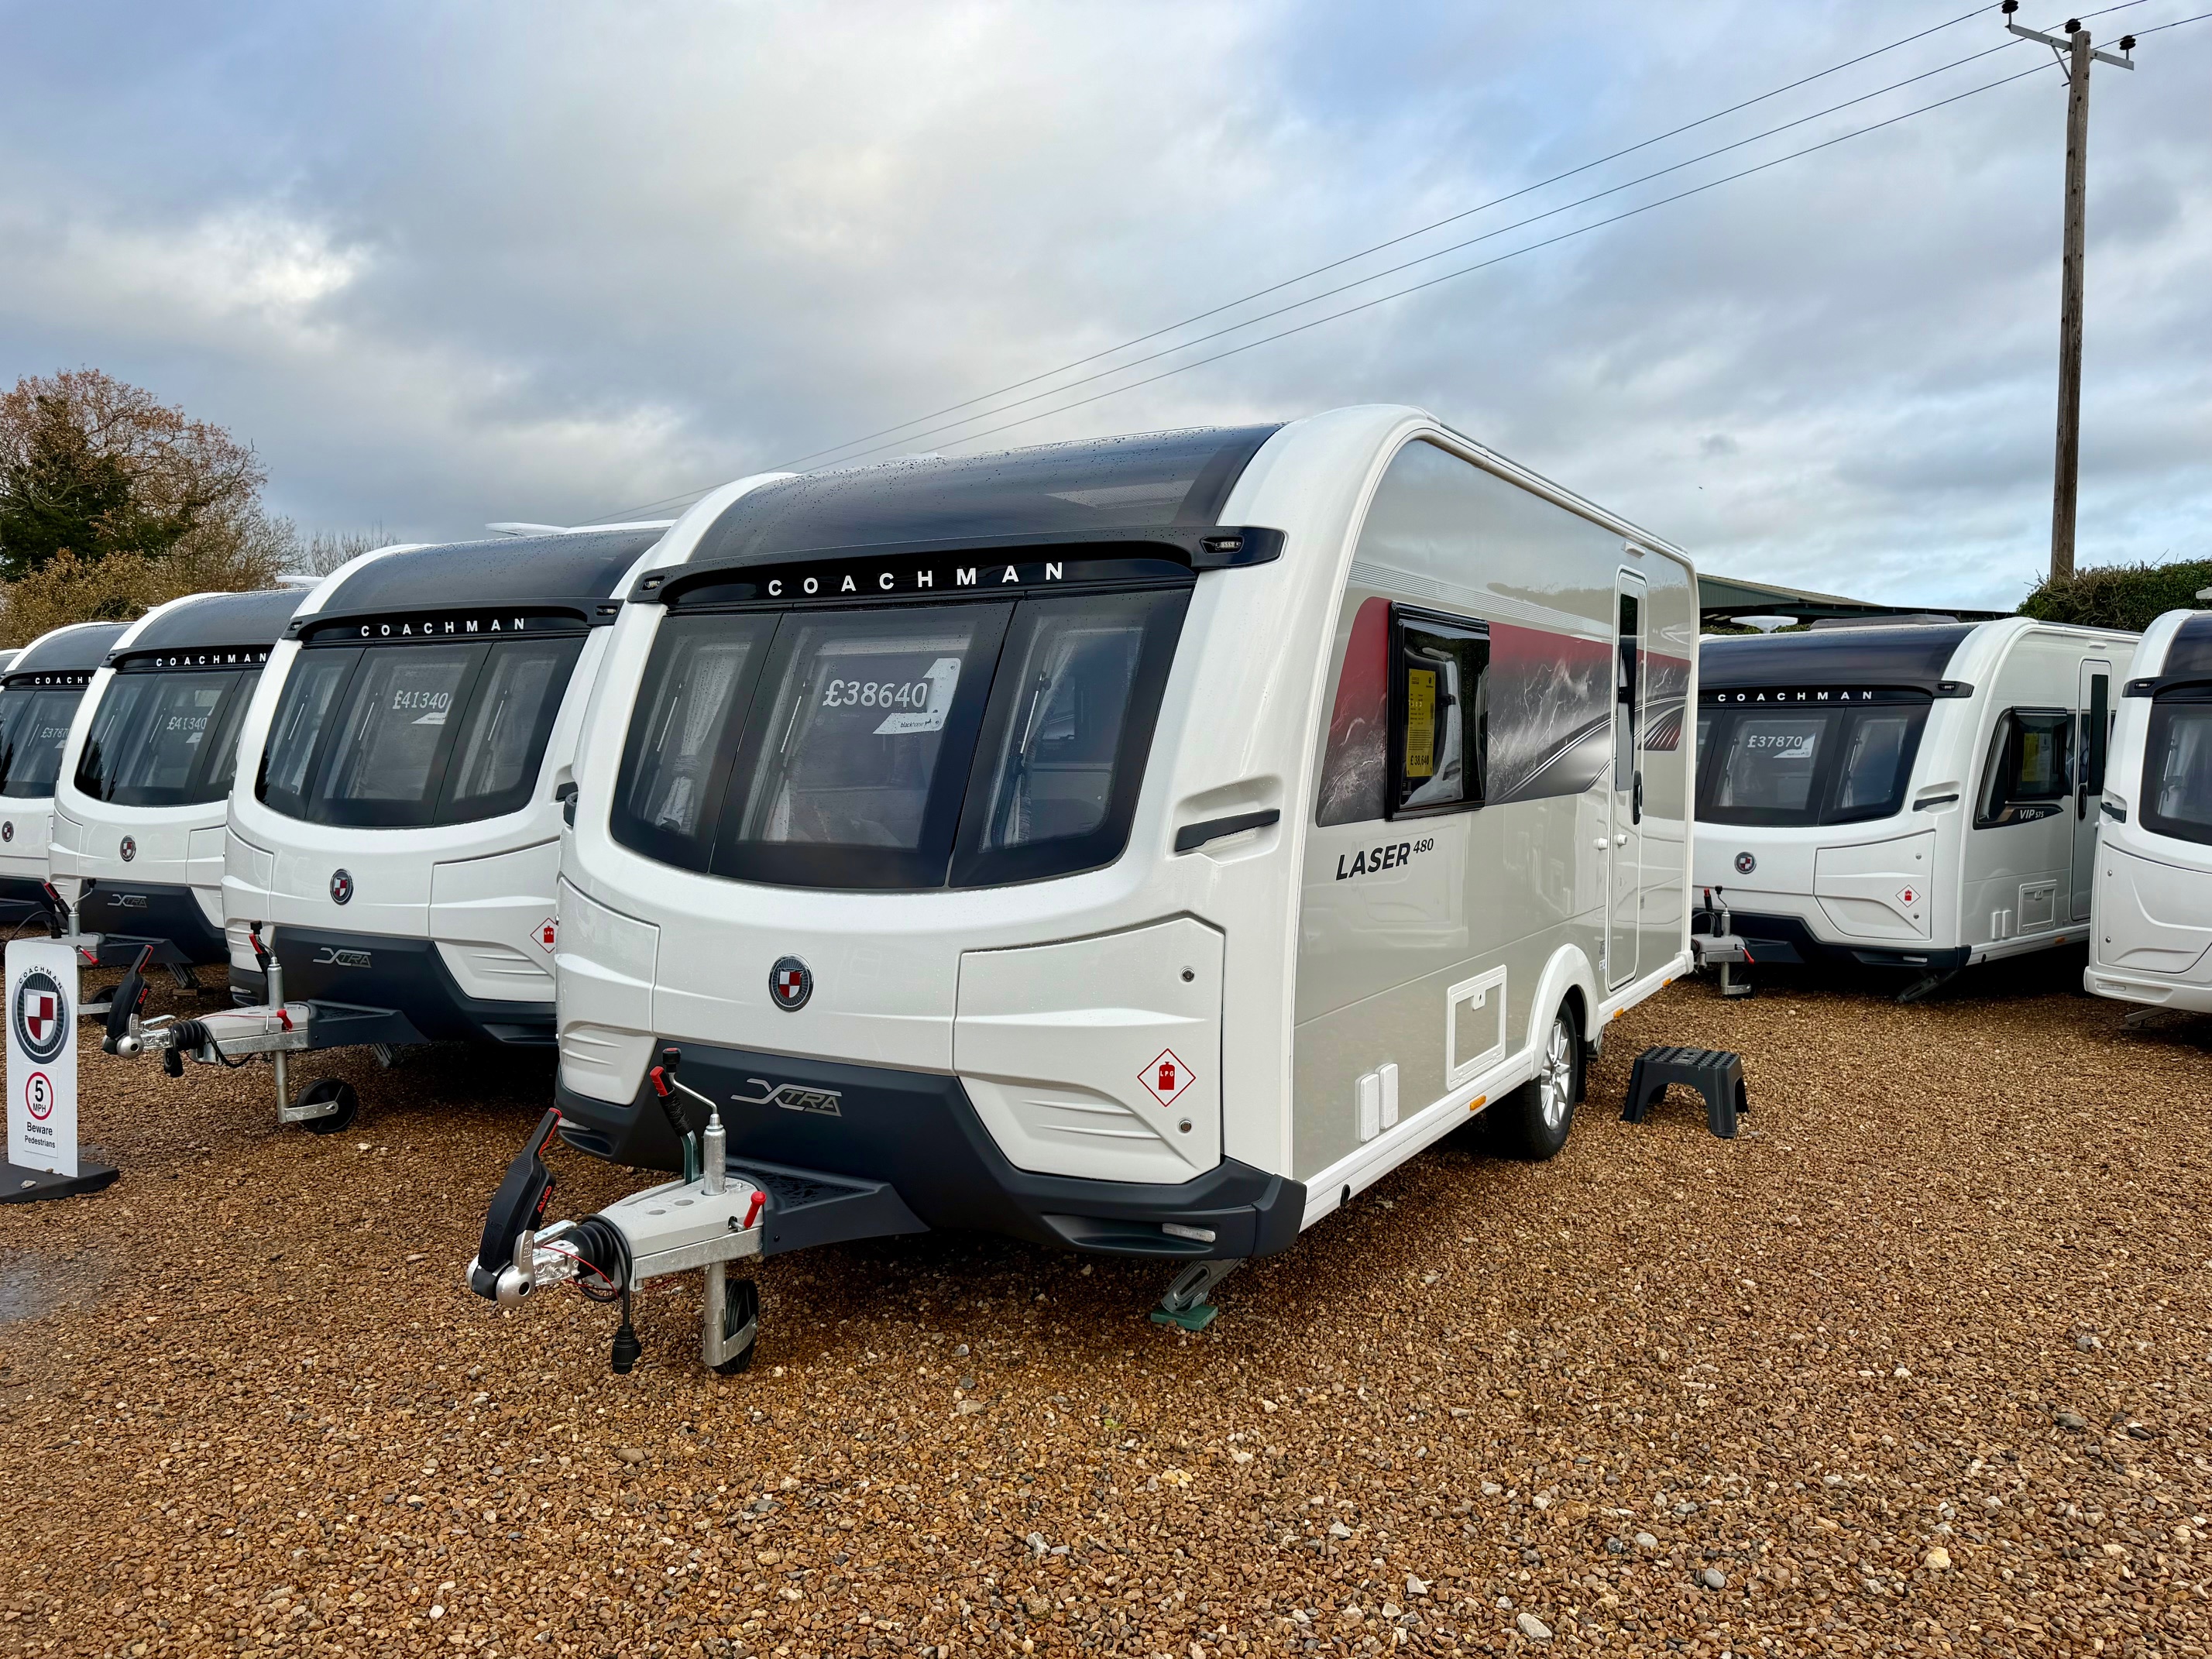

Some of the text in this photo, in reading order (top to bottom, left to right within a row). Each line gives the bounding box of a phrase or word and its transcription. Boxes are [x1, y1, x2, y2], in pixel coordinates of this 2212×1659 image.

[768, 562, 1063, 596] COACHMAN
[361, 618, 524, 637] COACHMAN
[156, 653, 266, 667] COACHMAN
[392, 689, 448, 709] £41340
[822, 679, 928, 708] £38640
[1717, 691, 1872, 702] COACHMAN
[167, 716, 208, 730] £41340
[1747, 735, 1803, 748] £37870
[2020, 809, 2035, 819] VIP
[1336, 838, 1434, 881] LASER 480
[107, 894, 148, 908] XTRA
[312, 946, 372, 968] XTRA
[19, 966, 63, 990] COACHMAN
[35, 1080, 44, 1102] 5
[730, 1078, 843, 1117] XTRA
[33, 1103, 46, 1113] MPH
[26, 1121, 53, 1136] Beware
[24, 1135, 56, 1149] Pedestrians
